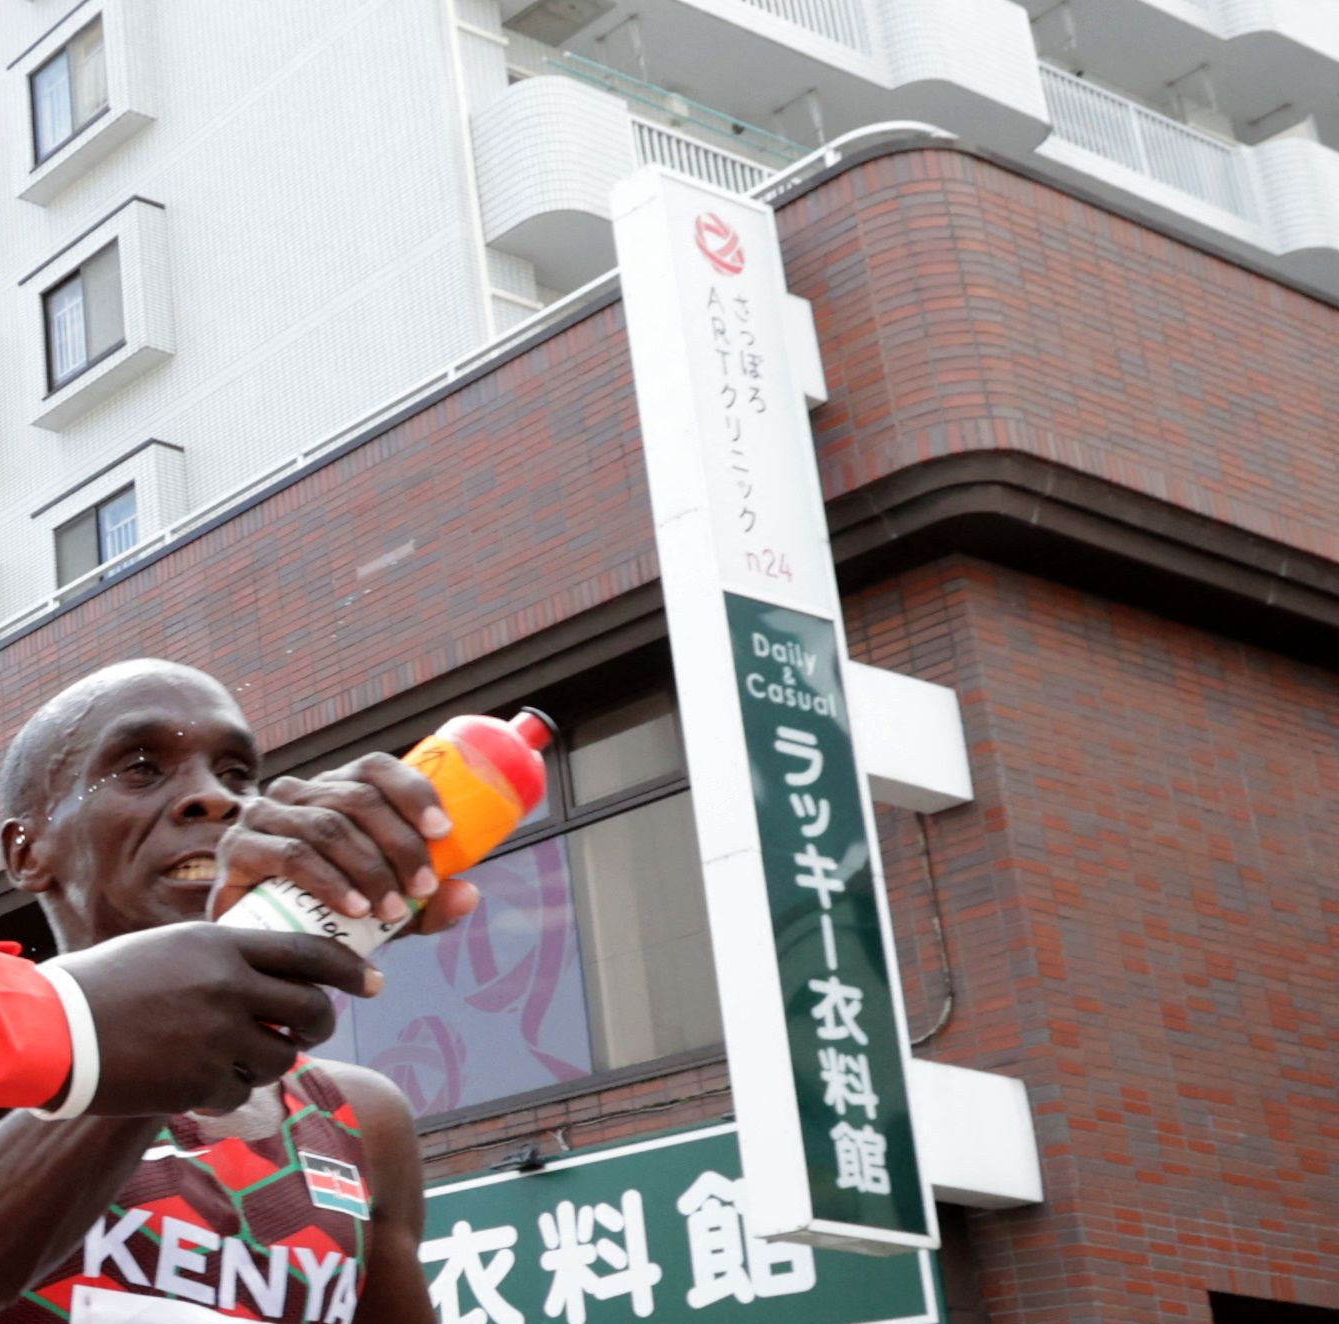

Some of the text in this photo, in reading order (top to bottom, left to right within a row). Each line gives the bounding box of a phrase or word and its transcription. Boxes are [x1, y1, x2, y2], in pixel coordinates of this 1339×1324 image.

[744, 549, 794, 582] n24
[752, 632, 817, 676] Daily
[781, 666, 796, 686] &
[746, 672, 837, 718] Casual
[773, 726, 893, 1197] ラッキー衣料館
